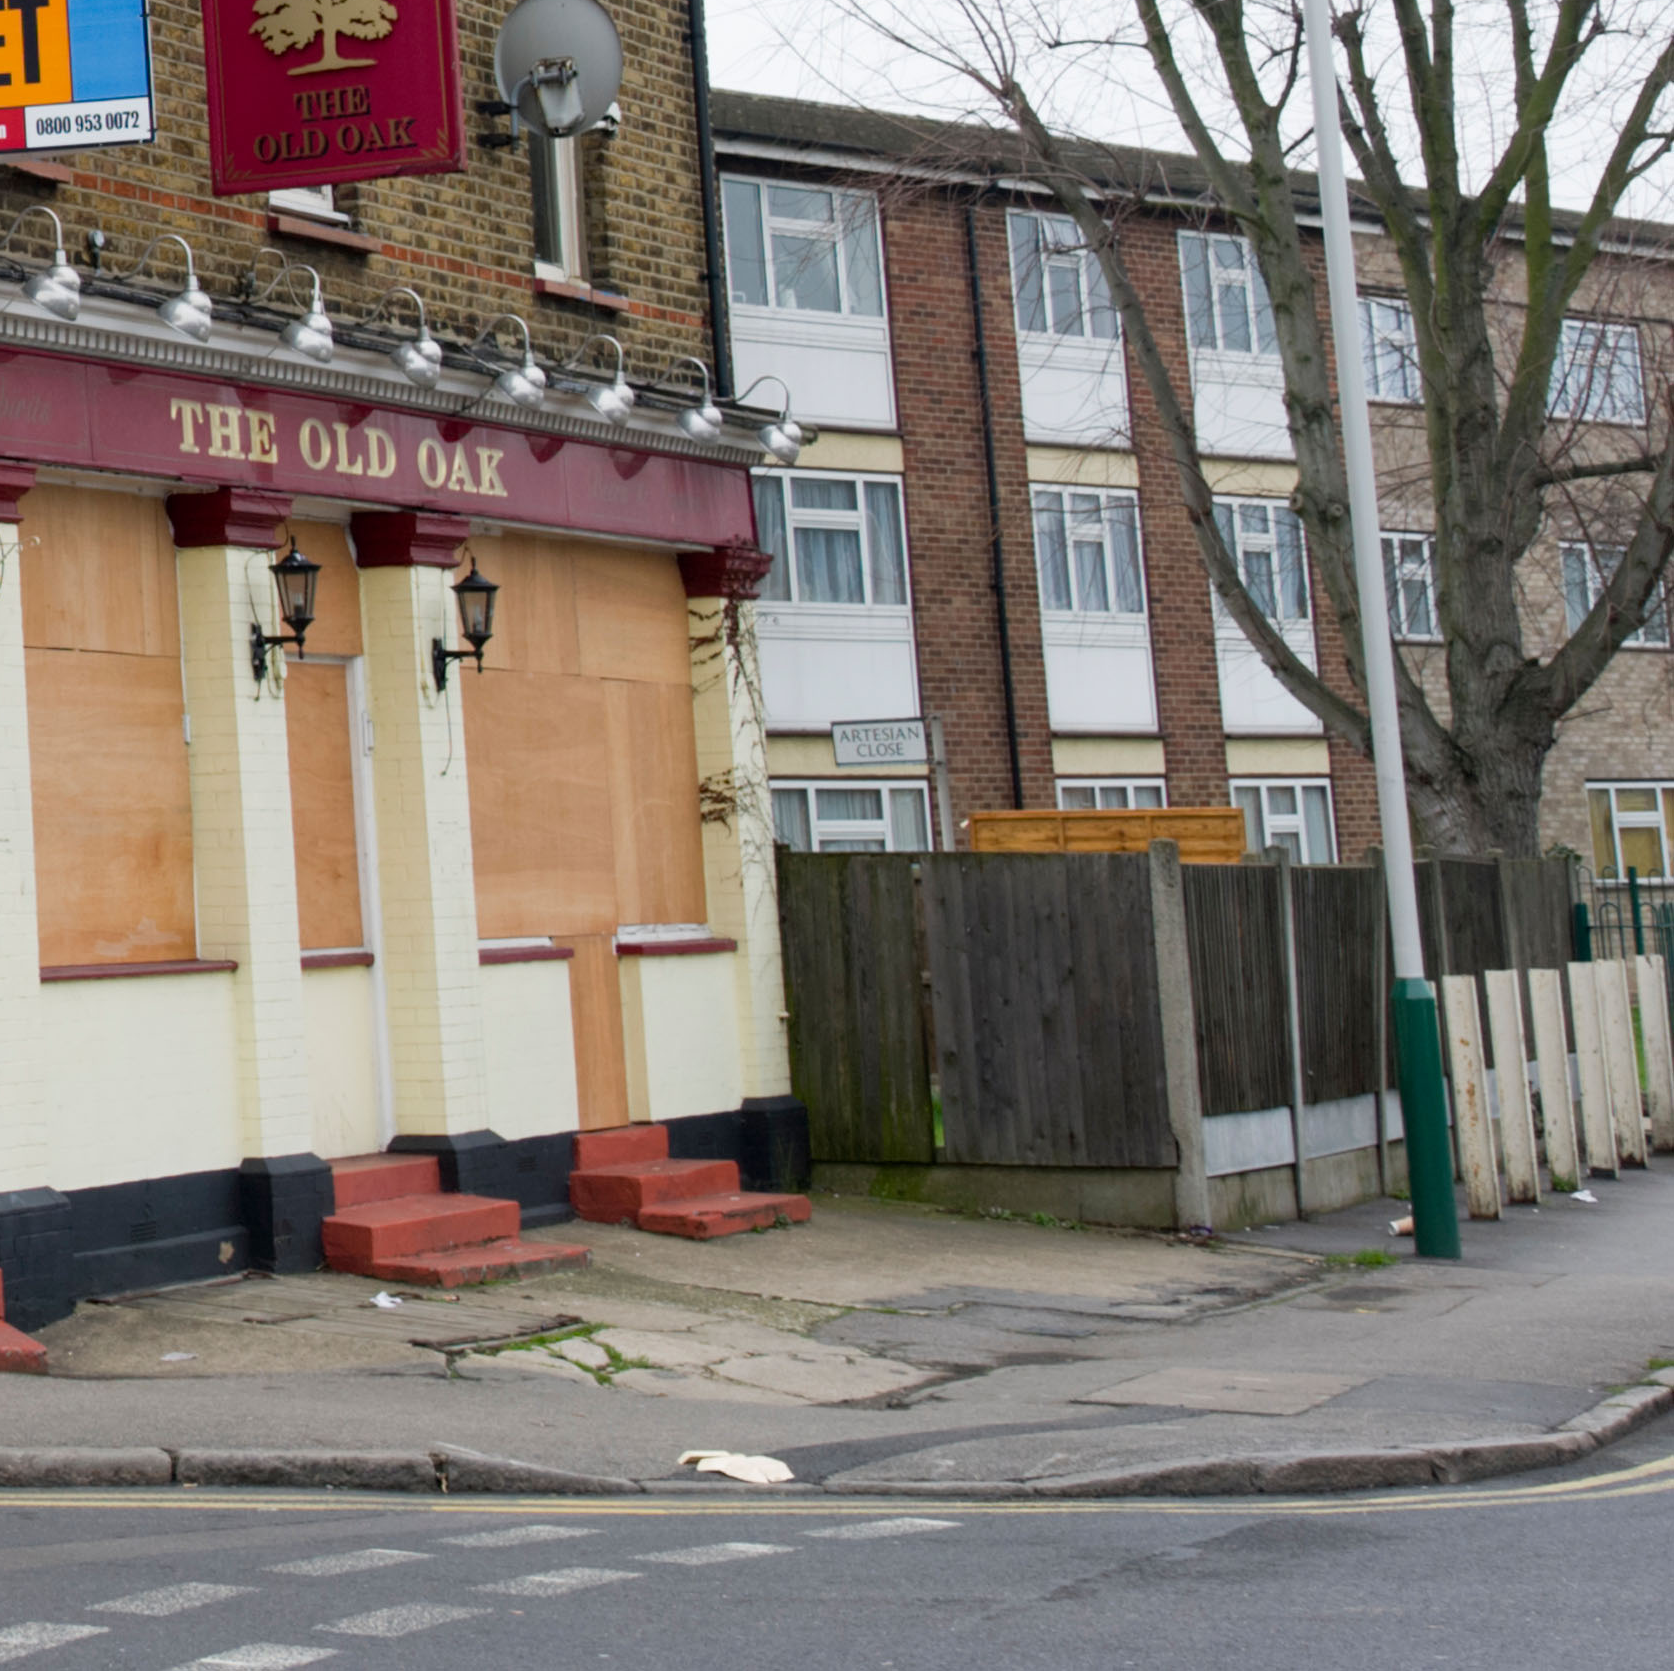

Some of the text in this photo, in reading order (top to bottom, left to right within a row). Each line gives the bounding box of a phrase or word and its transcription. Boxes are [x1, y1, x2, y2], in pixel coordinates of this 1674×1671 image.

[293, 85, 371, 122] THE
[36, 110, 140, 136] 0800 953 0072
[253, 116, 419, 164] OLD OAK
[170, 398, 509, 498] THE OLD OAK
[839, 726, 920, 743] ARTESIAN
[856, 742, 906, 758] CLOSE
